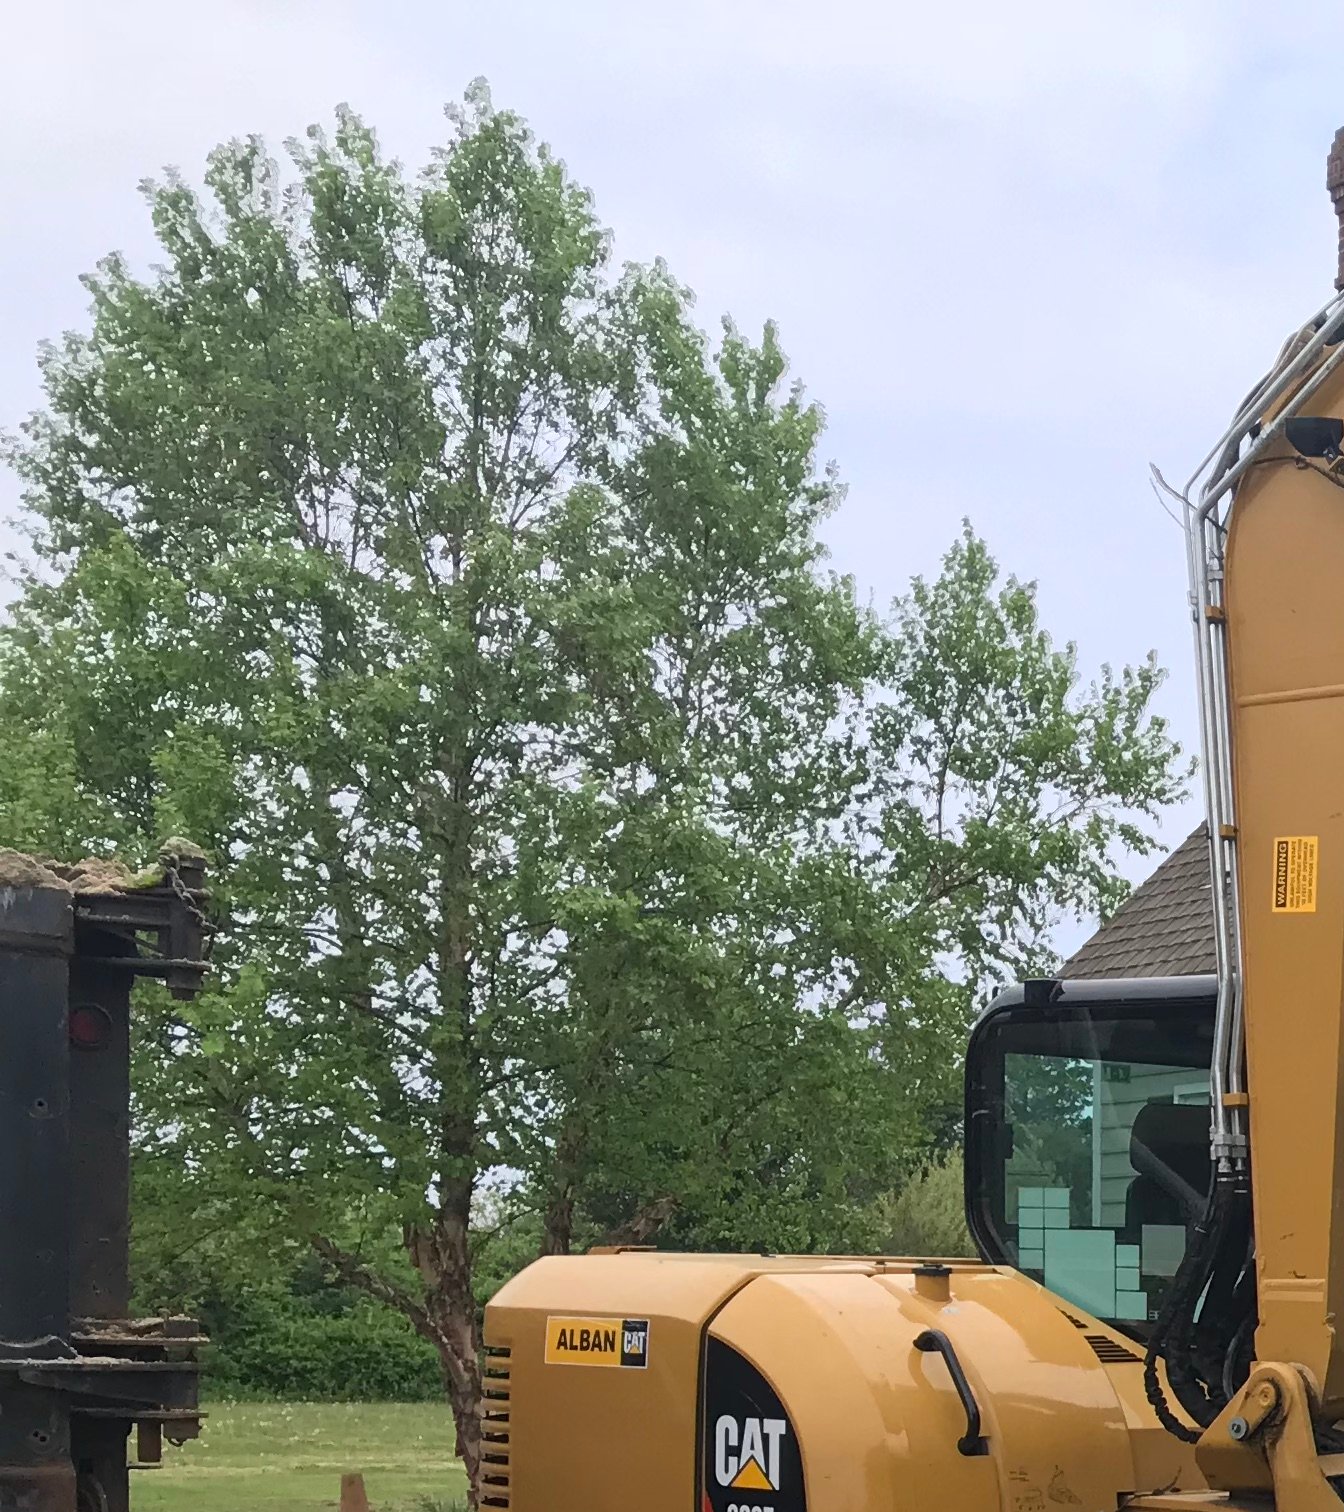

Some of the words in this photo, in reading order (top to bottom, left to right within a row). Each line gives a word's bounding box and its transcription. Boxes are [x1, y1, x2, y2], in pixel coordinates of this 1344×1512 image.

[1277, 843, 1287, 905] WARNING
[556, 1328, 616, 1352] ALBAN
[623, 1331, 647, 1354] CAT
[715, 1414, 787, 1491] CAT
